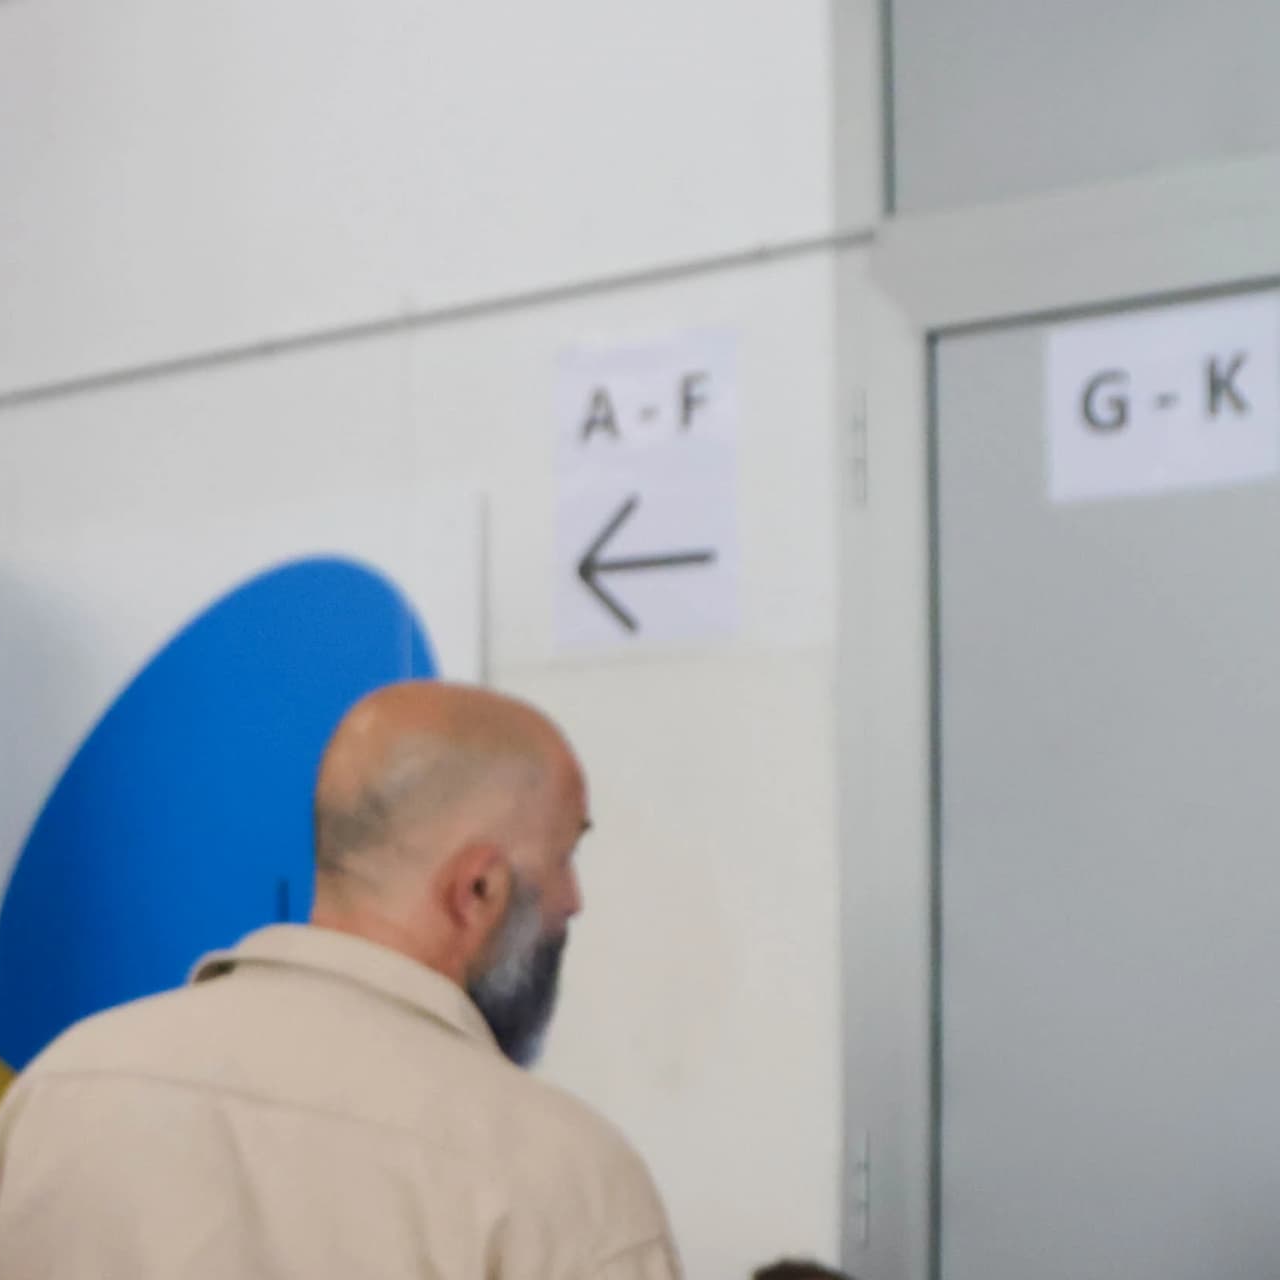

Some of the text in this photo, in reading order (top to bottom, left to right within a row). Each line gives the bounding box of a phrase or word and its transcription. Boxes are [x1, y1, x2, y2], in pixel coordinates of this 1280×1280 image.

[579, 385, 622, 444] A
[678, 371, 711, 431] F
[1080, 368, 1130, 434] G
[1203, 351, 1251, 417] K
